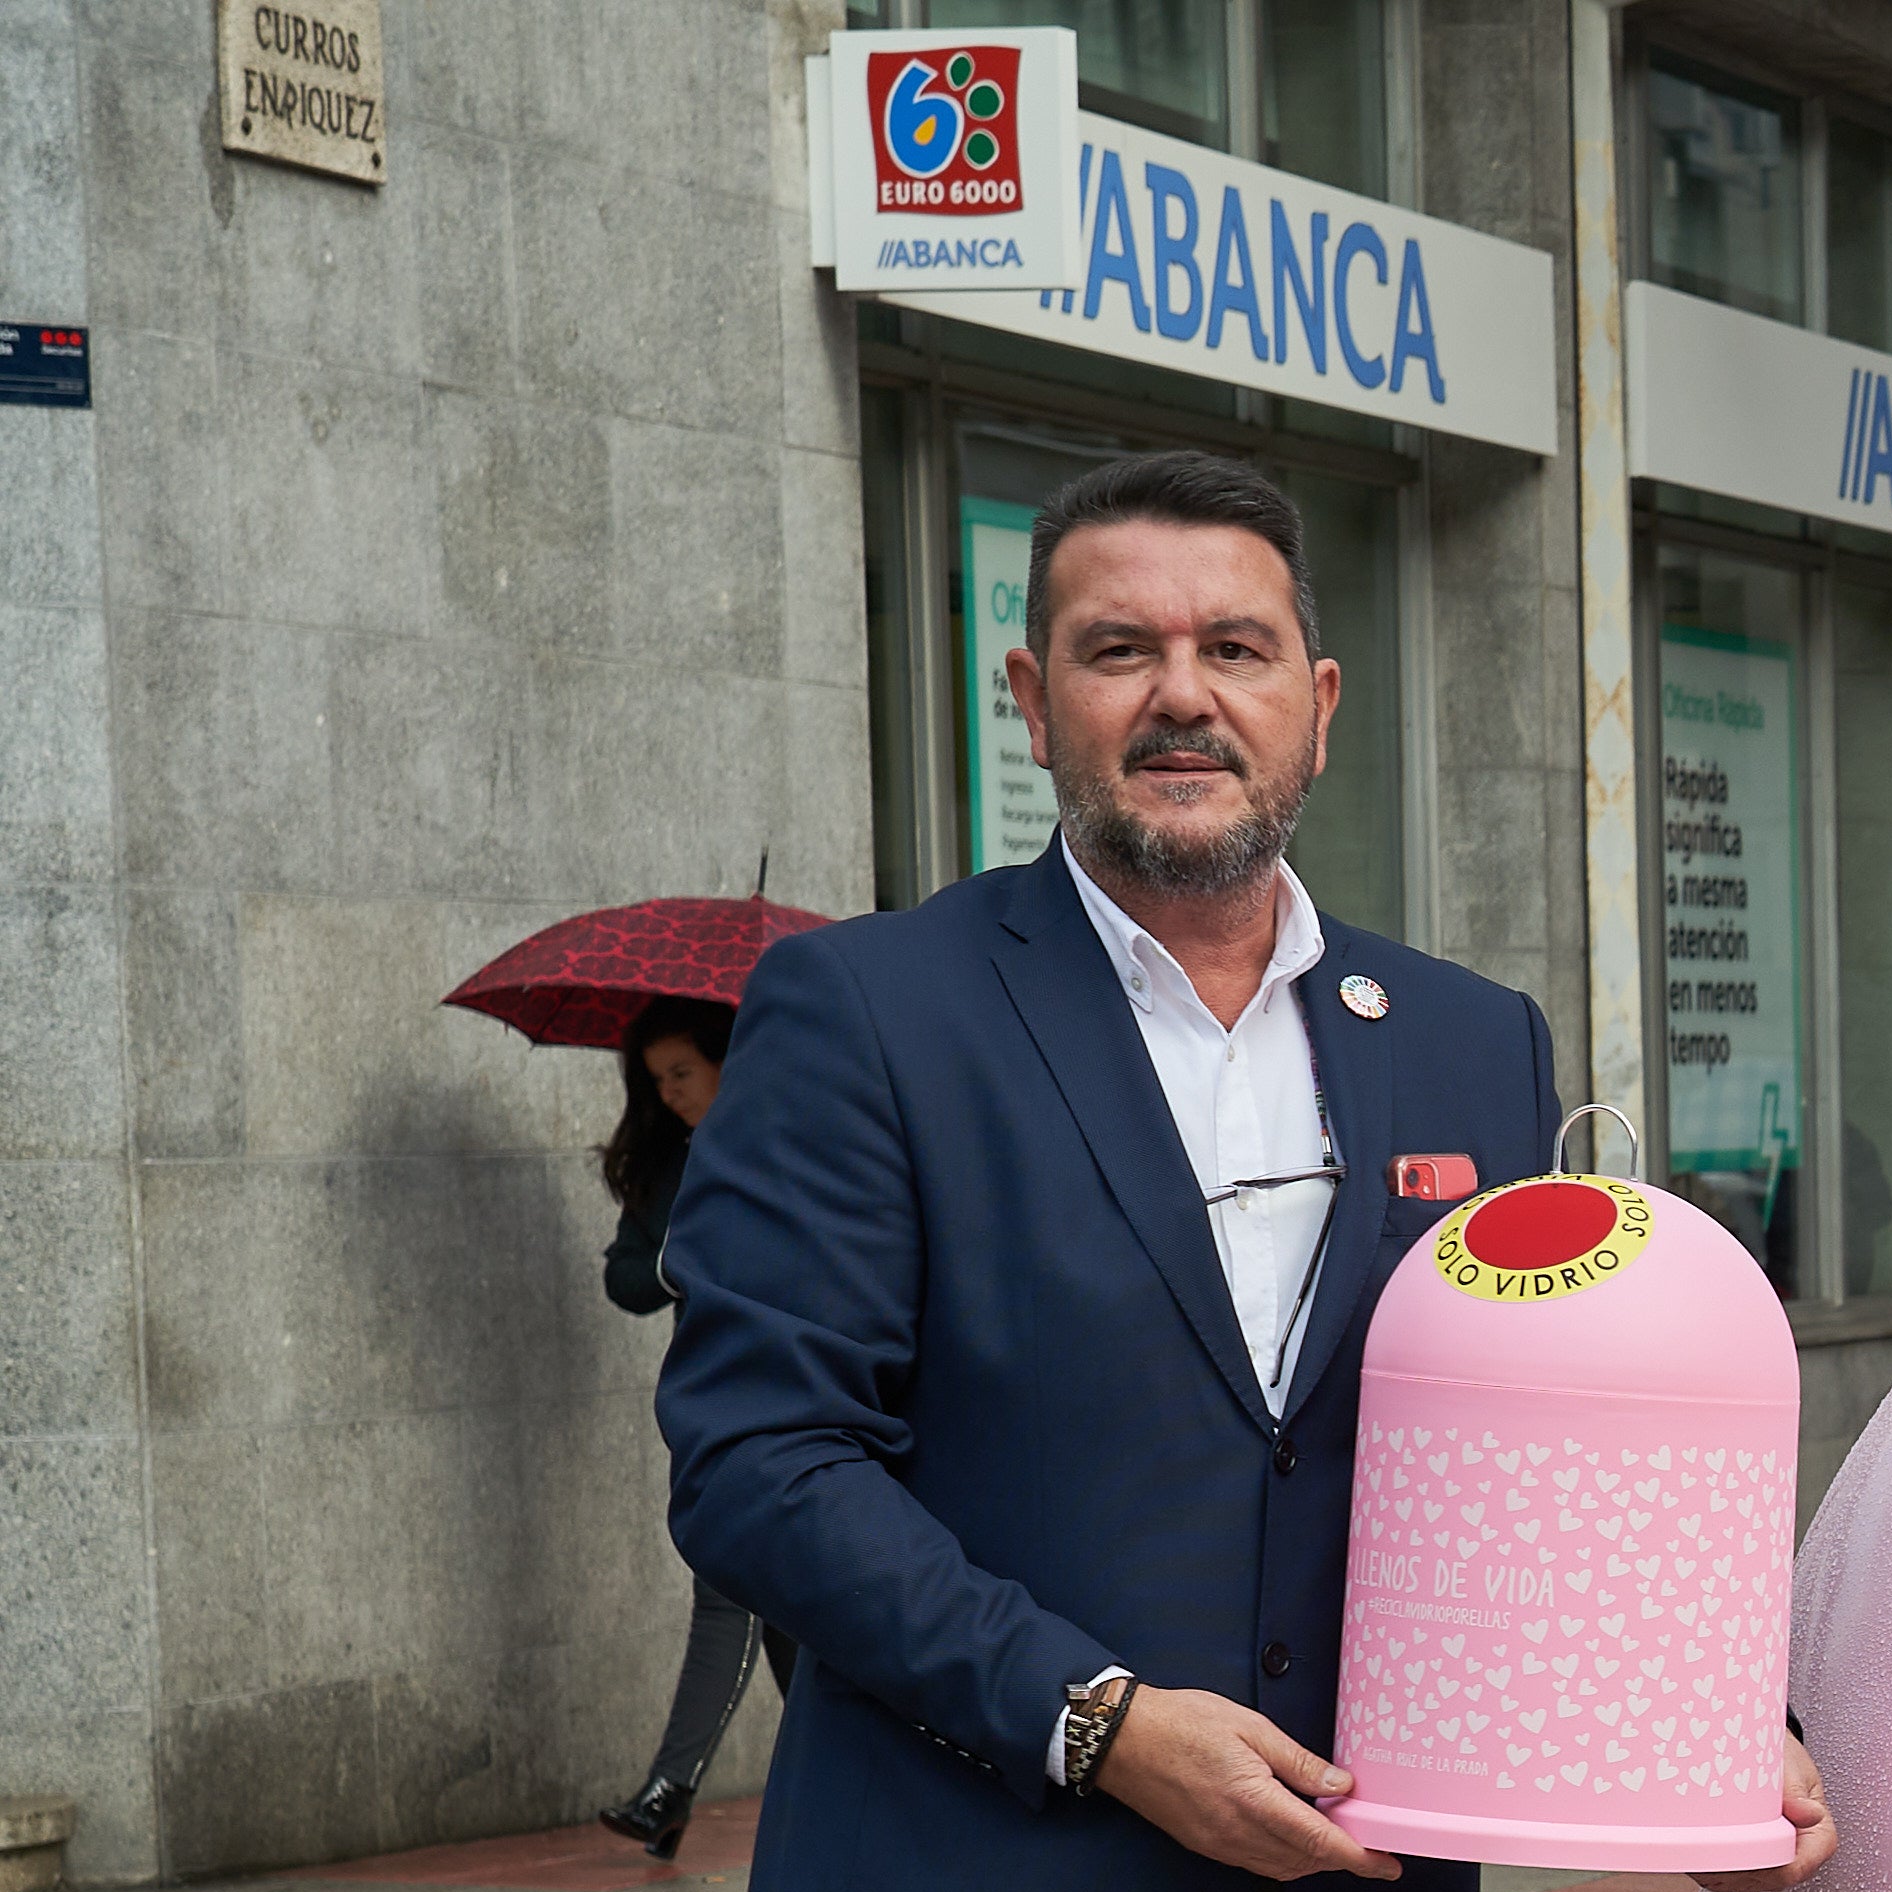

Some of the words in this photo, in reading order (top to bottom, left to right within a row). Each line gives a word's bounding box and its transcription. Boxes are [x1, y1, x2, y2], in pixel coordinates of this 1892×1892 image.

[255, 6, 361, 74] CURROS
[244, 67, 376, 143] ENRIQUEZ
[880, 180, 946, 205] EURO
[950, 179, 1017, 204] 6000
[1665, 756, 1729, 812] Rápida
[1666, 812, 1743, 865] significa
[1667, 873, 1678, 907] a
[1682, 874, 1749, 910] mesma
[1669, 917, 1749, 962] atención
[1669, 979, 1692, 1014] en
[1697, 980, 1759, 1015] menos
[1670, 1026, 1731, 1075] tempo
[1607, 1183, 1650, 1238] SOLO
[1438, 1226, 1479, 1286] SOLO
[1495, 1249, 1619, 1297] VIDRIO
[1353, 1546, 1422, 1594] LLENOS
[1433, 1558, 1468, 1598] DE
[1484, 1564, 1555, 1608] VIDA
[1367, 1596, 1512, 1630] #RECICLAVIDRIOPORELLAS
[1421, 1755, 1434, 1771] DE
[1437, 1757, 1451, 1773] LA
[1454, 1759, 1489, 1777] PRADA
